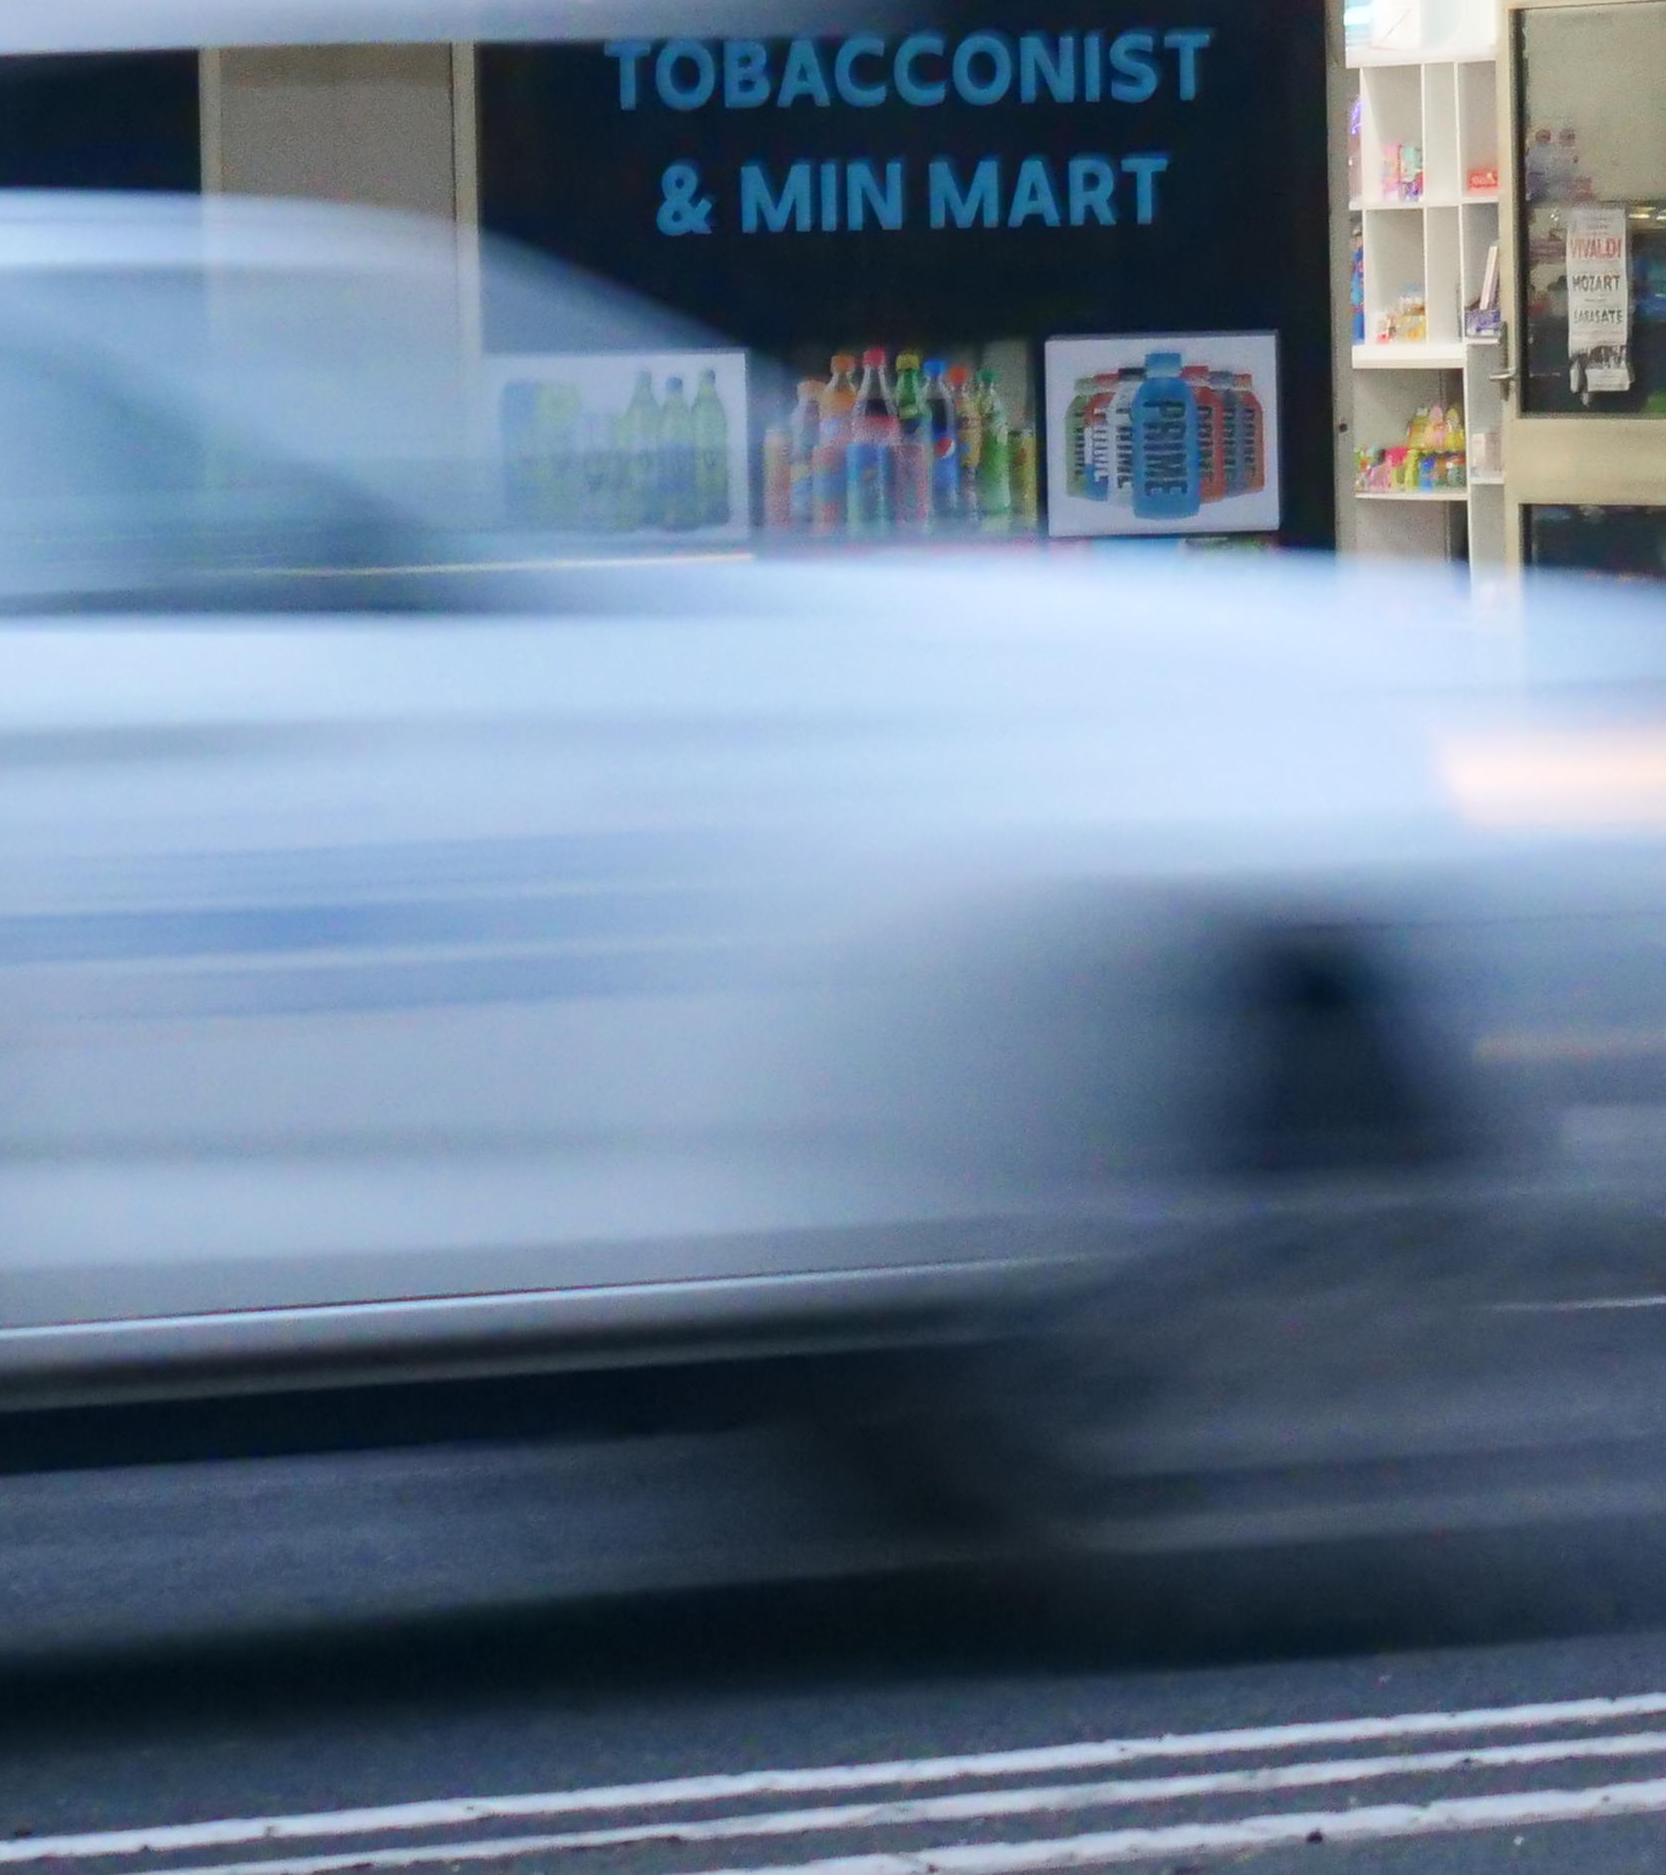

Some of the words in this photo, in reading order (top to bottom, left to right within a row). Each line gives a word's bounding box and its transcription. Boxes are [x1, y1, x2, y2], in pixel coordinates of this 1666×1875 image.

[604, 28, 1215, 111] TOBACCONIST
[655, 158, 714, 236] &
[740, 159, 904, 234] MIN
[928, 153, 1170, 230] MART
[1569, 236, 1622, 261] VIVALDI
[1572, 275, 1621, 294] MOZART
[1144, 400, 1188, 496] PRIME
